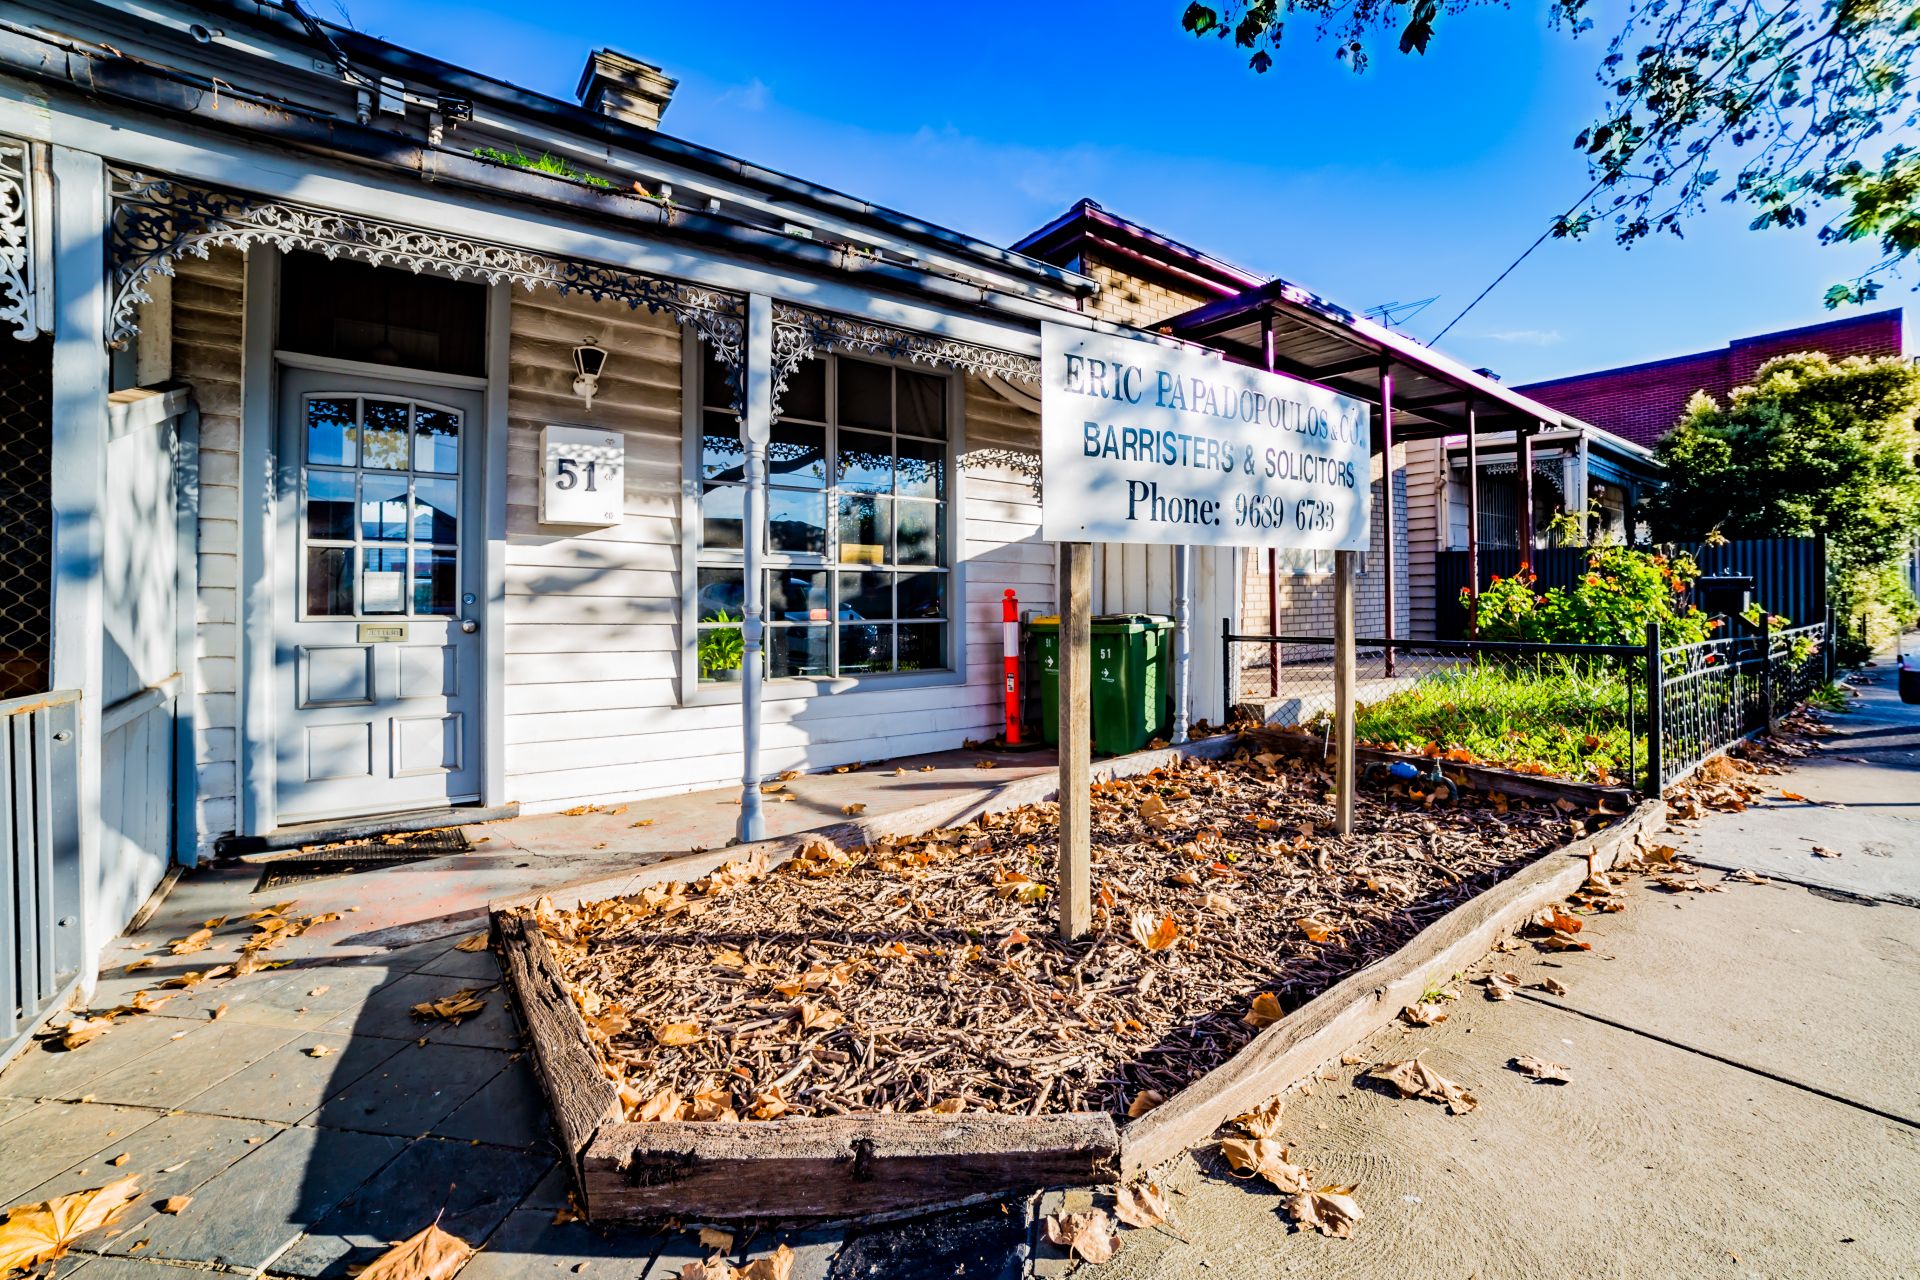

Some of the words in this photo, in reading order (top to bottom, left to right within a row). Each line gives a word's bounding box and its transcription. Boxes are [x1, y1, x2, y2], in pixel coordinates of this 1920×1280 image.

[1064, 353, 1142, 404] ERIC
[1156, 370, 1328, 439] PAPADOPOULOS
[1331, 425, 1338, 441] &
[1340, 414, 1363, 447] CO.
[555, 458, 597, 492] 51
[1084, 421, 1234, 473] BARRISTERS
[1243, 445, 1255, 475] &
[1265, 447, 1354, 488] SOLICITORS
[1126, 480, 1220, 526] Phone:
[1236, 493, 1284, 528] 9689
[1296, 499, 1334, 531] 6733
[1100, 648, 1111, 659] 51
